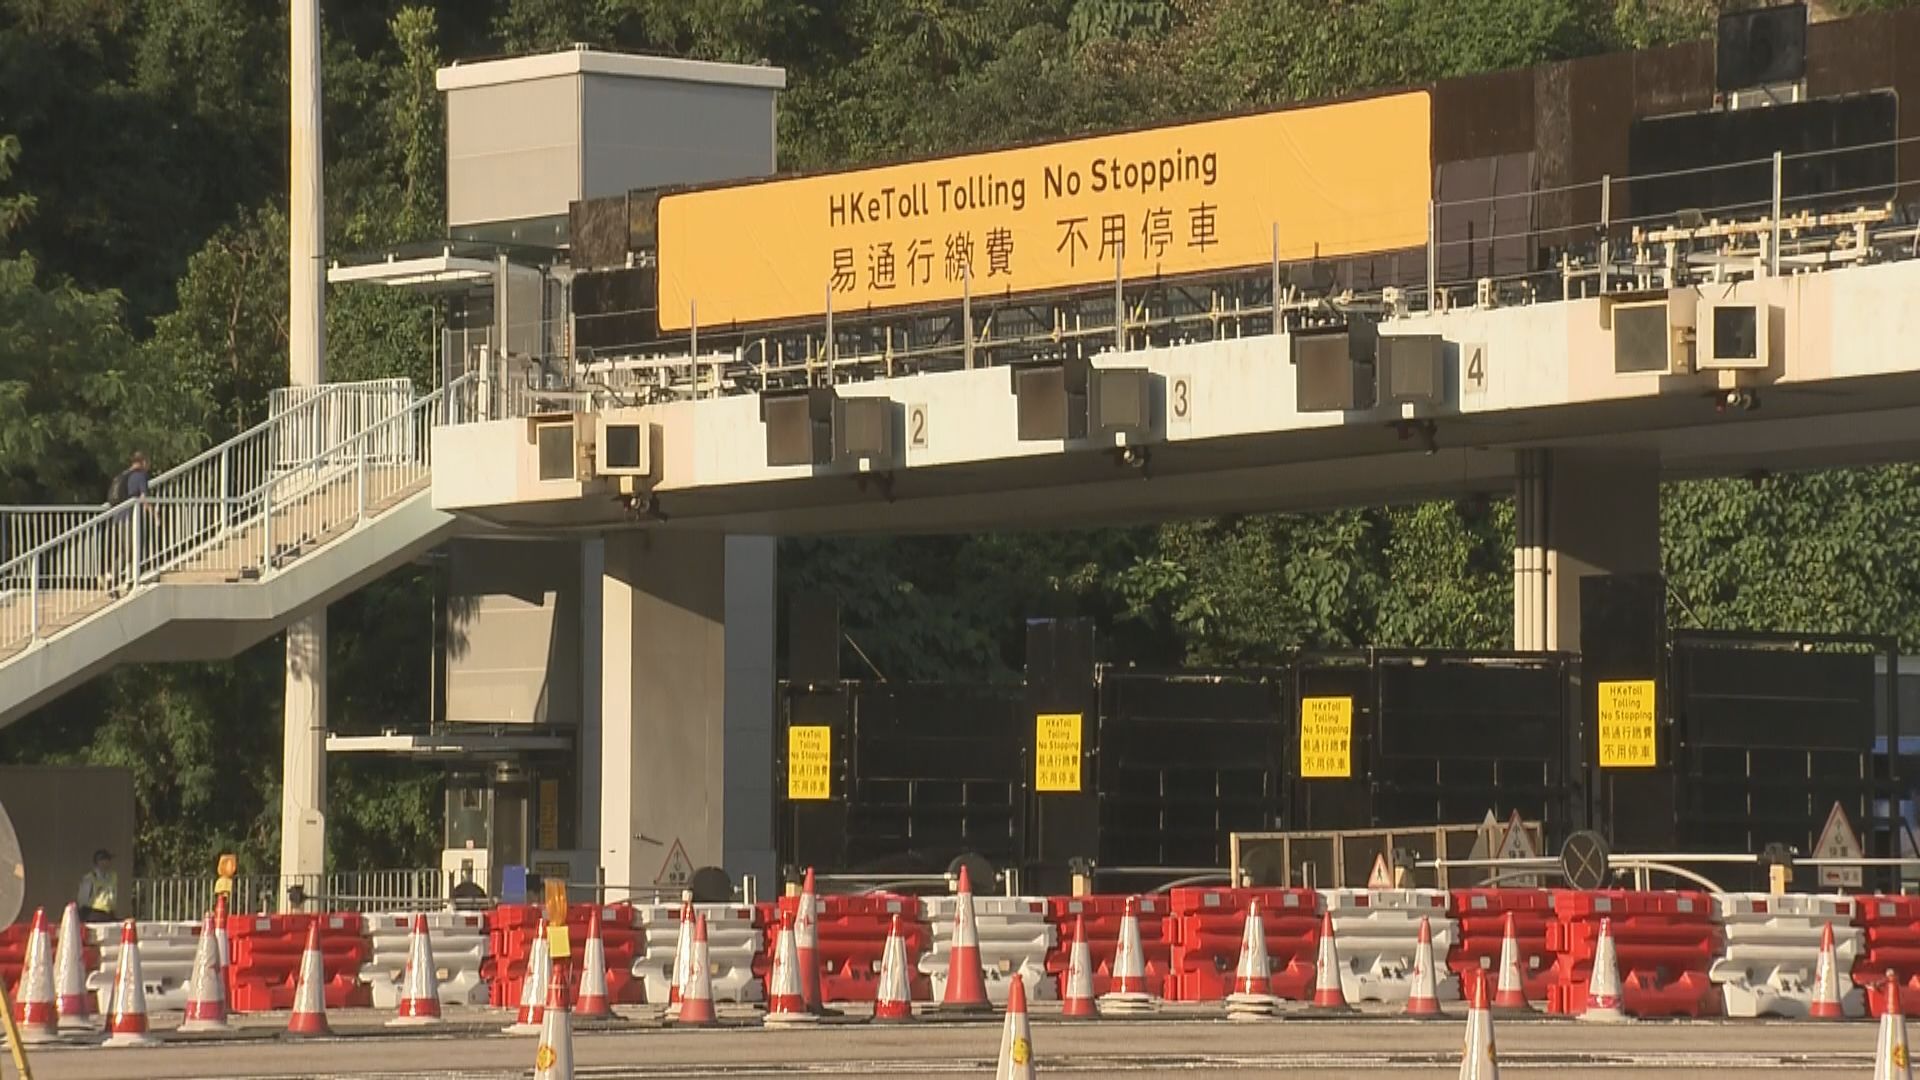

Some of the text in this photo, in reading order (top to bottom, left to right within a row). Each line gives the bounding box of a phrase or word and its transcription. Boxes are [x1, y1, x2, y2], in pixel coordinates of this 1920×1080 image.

[830, 148, 1218, 227] HKeToll Tolling No Stopping
[829, 201, 1220, 294] 易通行繳費 不用停車
[1467, 347, 1484, 387] 4
[1174, 379, 1188, 418] 3
[912, 409, 925, 444] 2
[1610, 686, 1642, 696] HKeToll
[1613, 698, 1641, 709] Tolling
[1601, 710, 1652, 721] No Stopping
